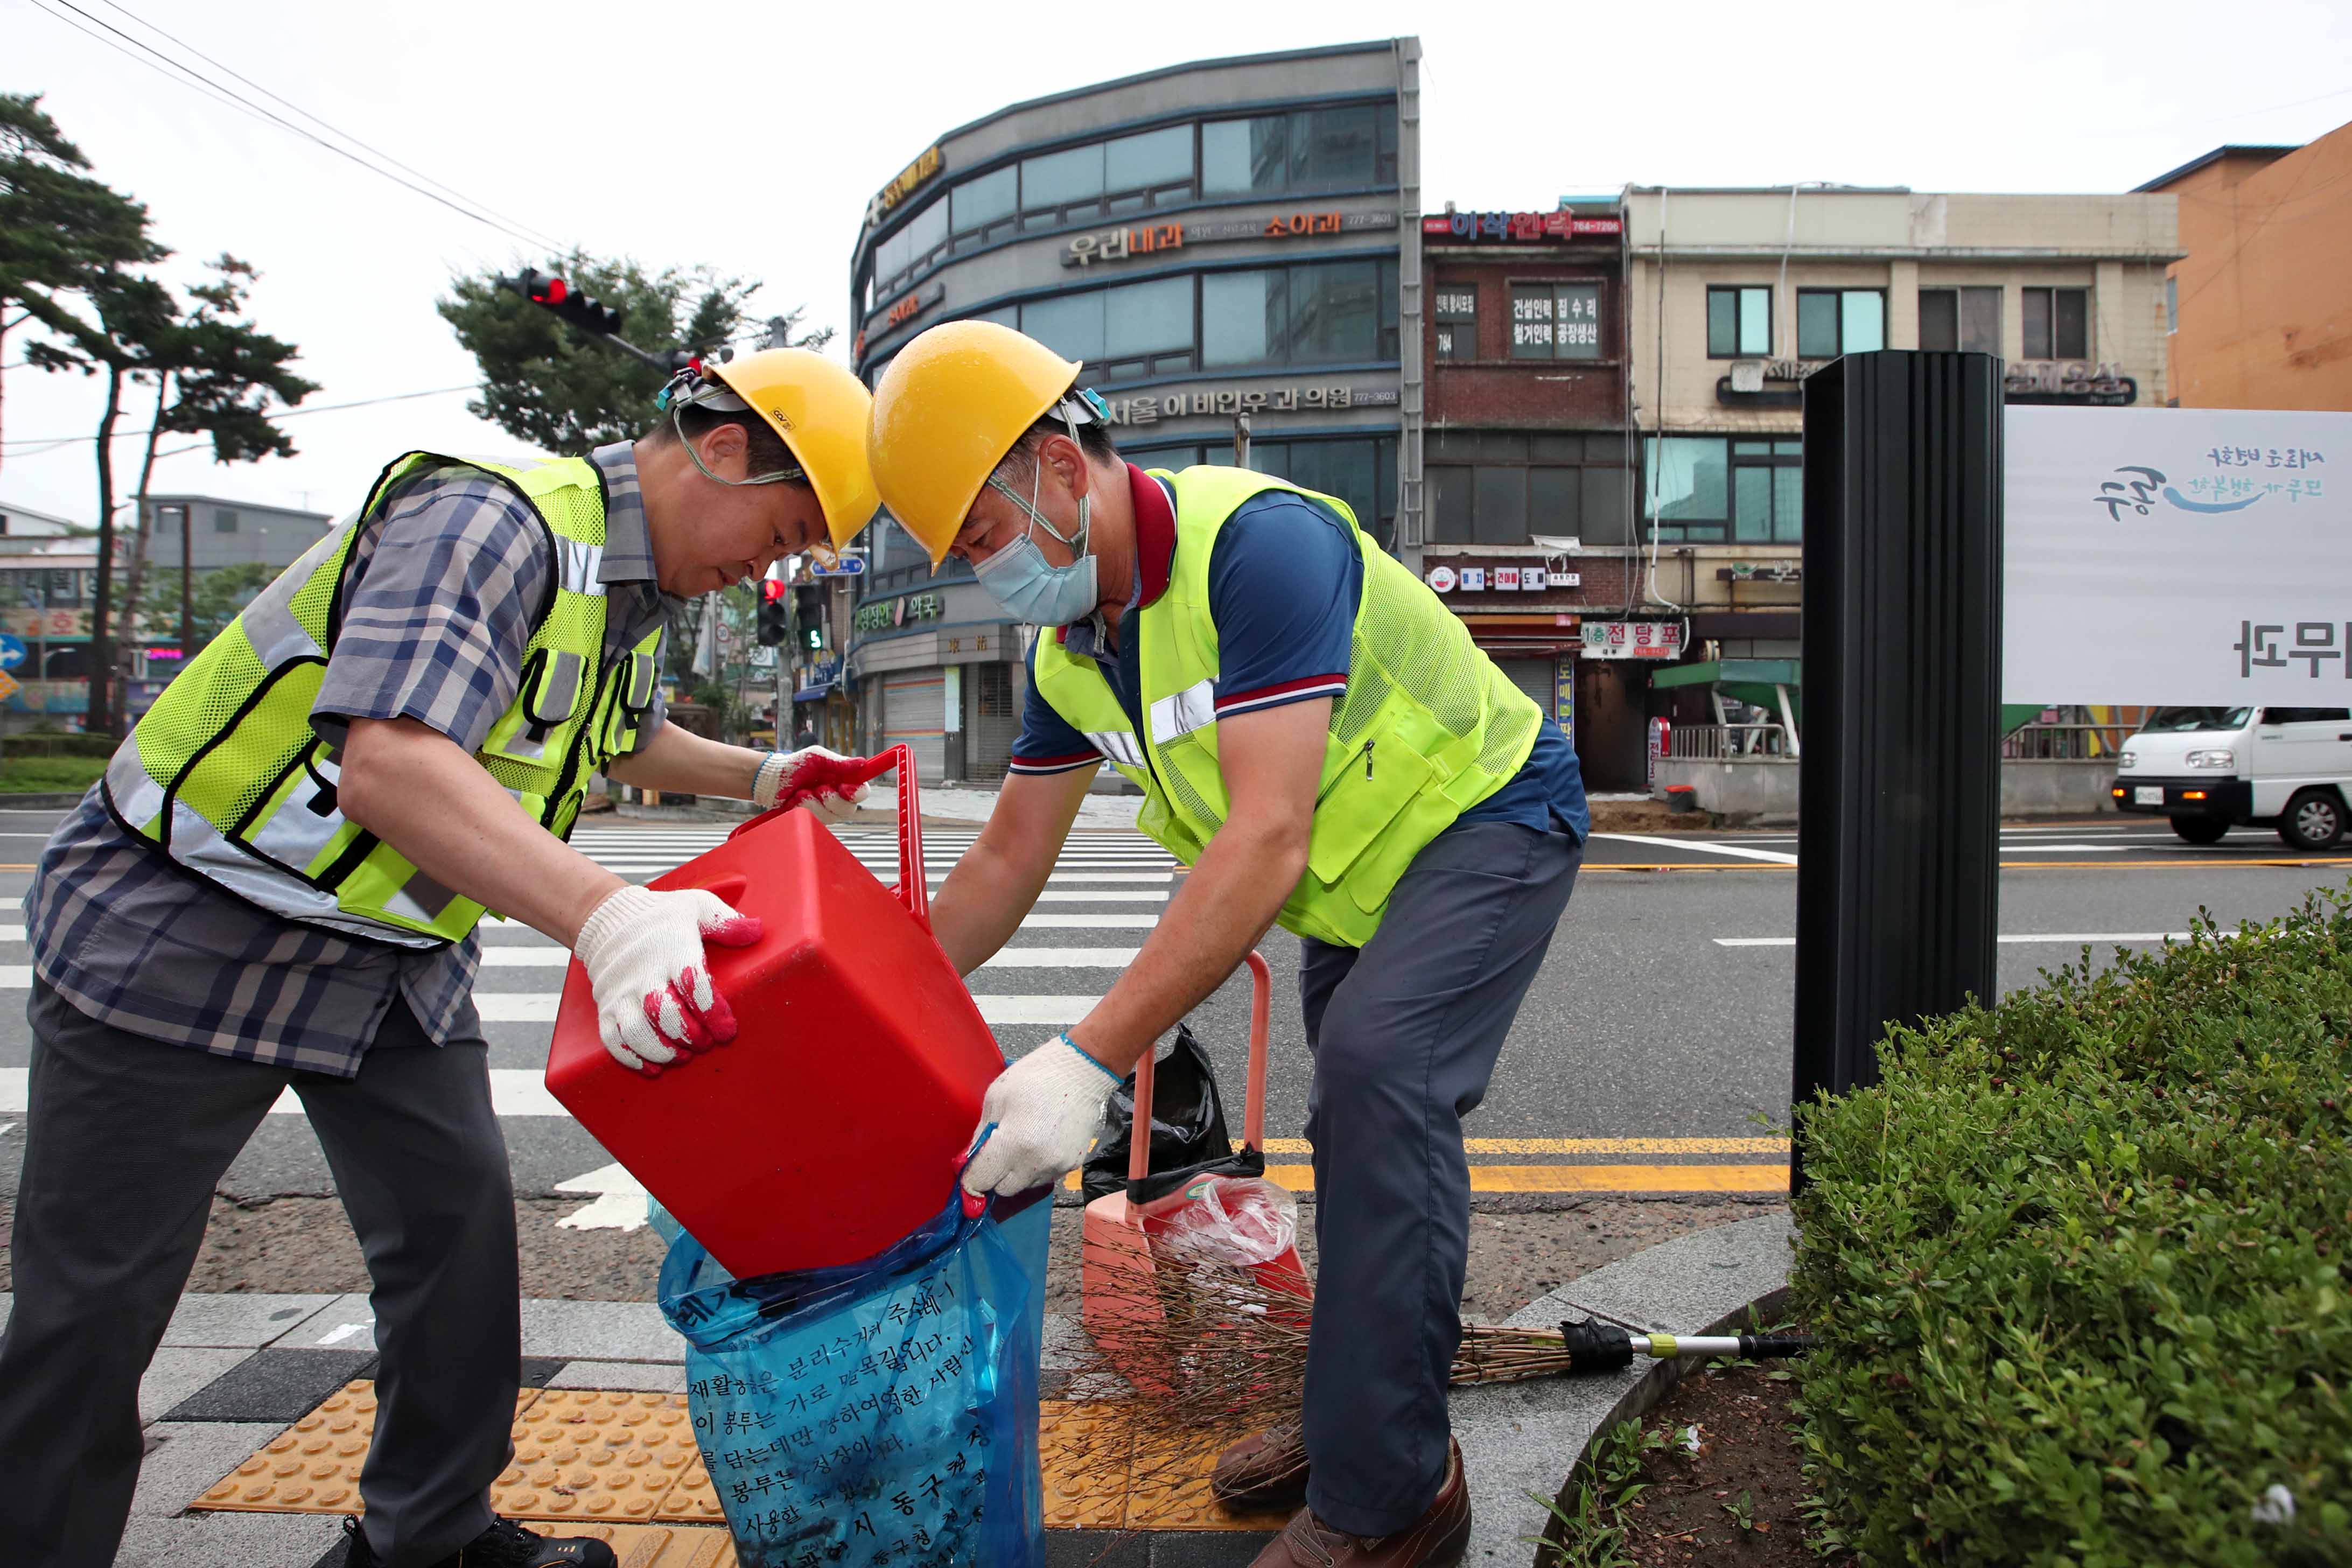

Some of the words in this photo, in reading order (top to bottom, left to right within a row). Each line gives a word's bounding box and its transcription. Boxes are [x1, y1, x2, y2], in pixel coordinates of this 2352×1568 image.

[1263, 211, 1342, 237] 소아과
[1514, 298, 1552, 319] 건설인력
[1514, 323, 1552, 345] 철거인력
[1557, 323, 1597, 345] 공장생산
[1354, 391, 1396, 403] 777-3603
[911, 594, 937, 621] 약국
[1608, 624, 1680, 645] 전당포
[695, 1411, 713, 1435] 이
[723, 1411, 776, 1436] 봉투는
[784, 1383, 832, 1415] 가로
[731, 1470, 796, 1504] 봉투는
[744, 1505, 802, 1538] 사용할
